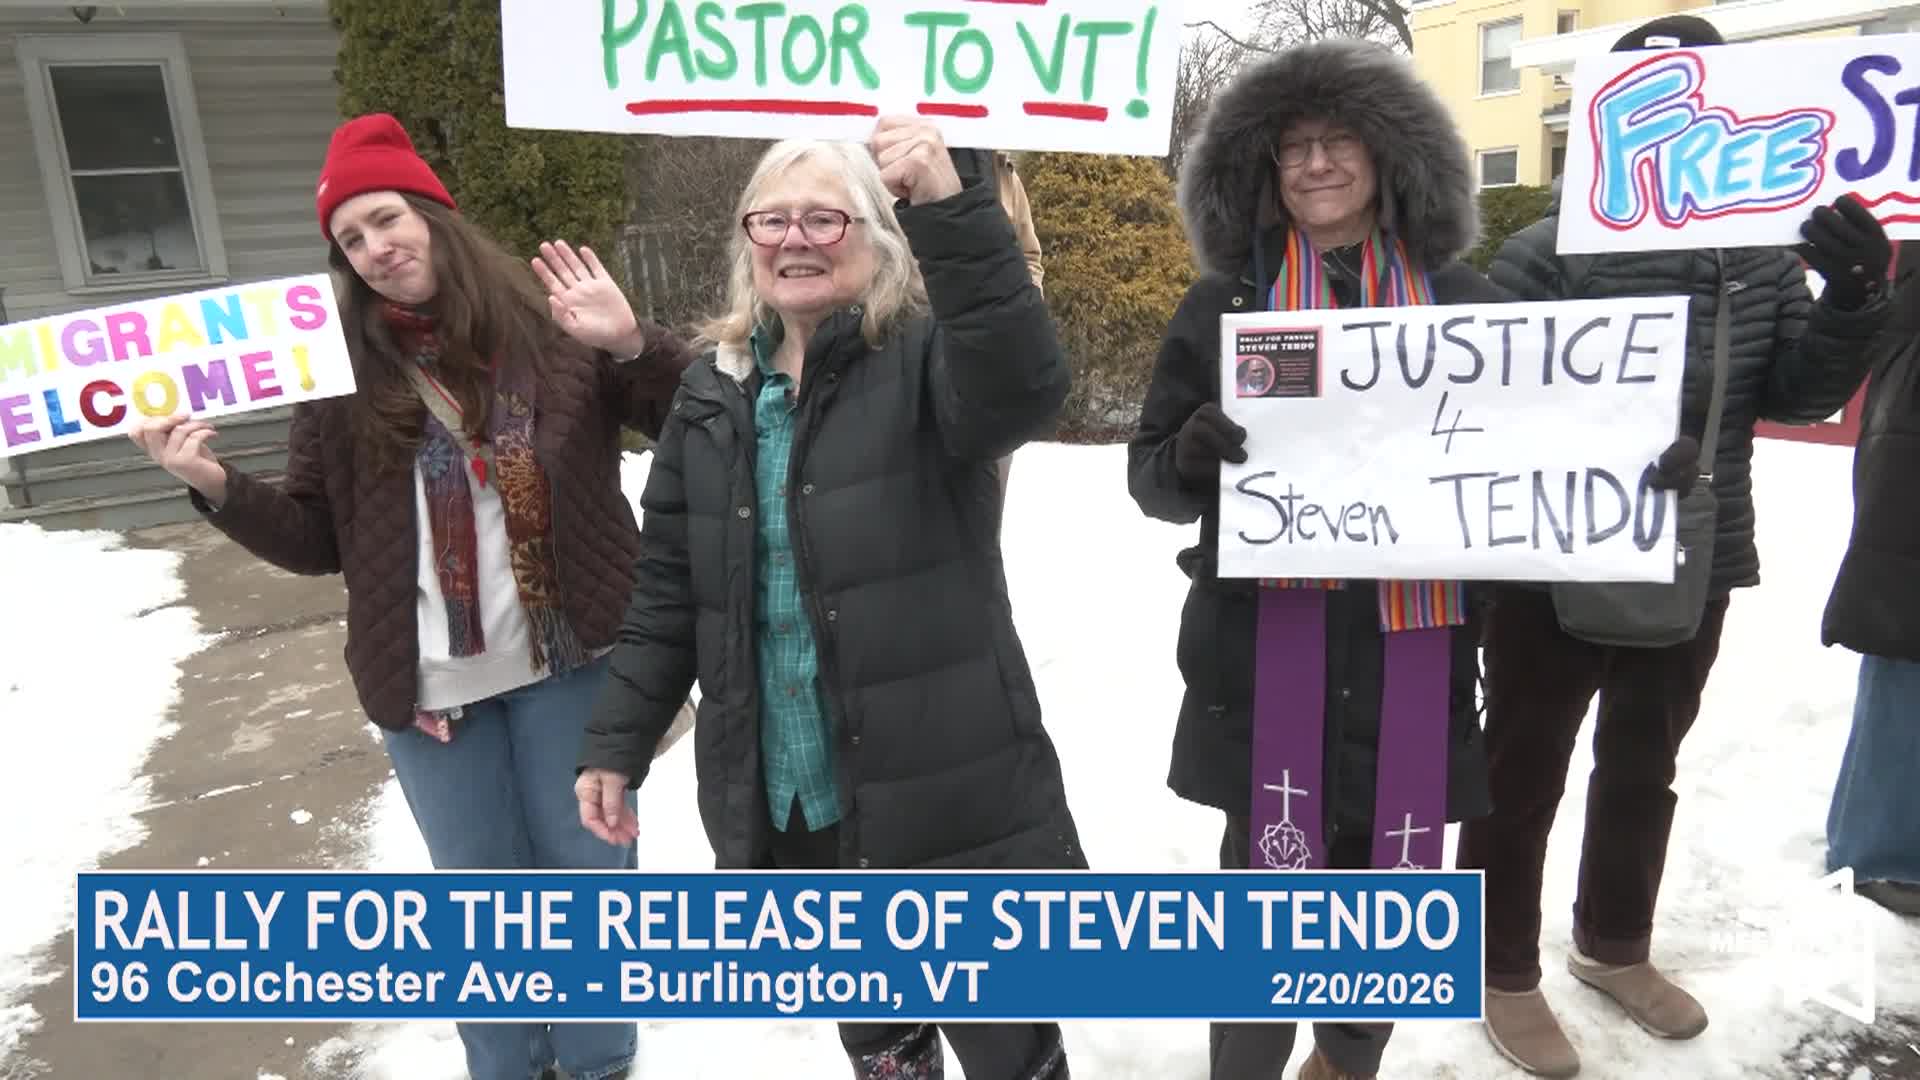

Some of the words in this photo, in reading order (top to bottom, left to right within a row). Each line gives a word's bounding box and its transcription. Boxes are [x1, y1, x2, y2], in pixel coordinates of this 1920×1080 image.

[602, 0, 880, 89] PASTOR
[905, 12, 993, 95] TO
[1016, 7, 1158, 118] VT!
[1597, 60, 1826, 222] FREE
[1239, 343, 1278, 352] STEVEN
[1280, 342, 1315, 351] TENDO
[1340, 312, 1675, 391] JUSTICE
[1431, 391, 1484, 454] 4
[1235, 471, 1399, 546] Steven
[1429, 462, 1667, 554] TENDO
